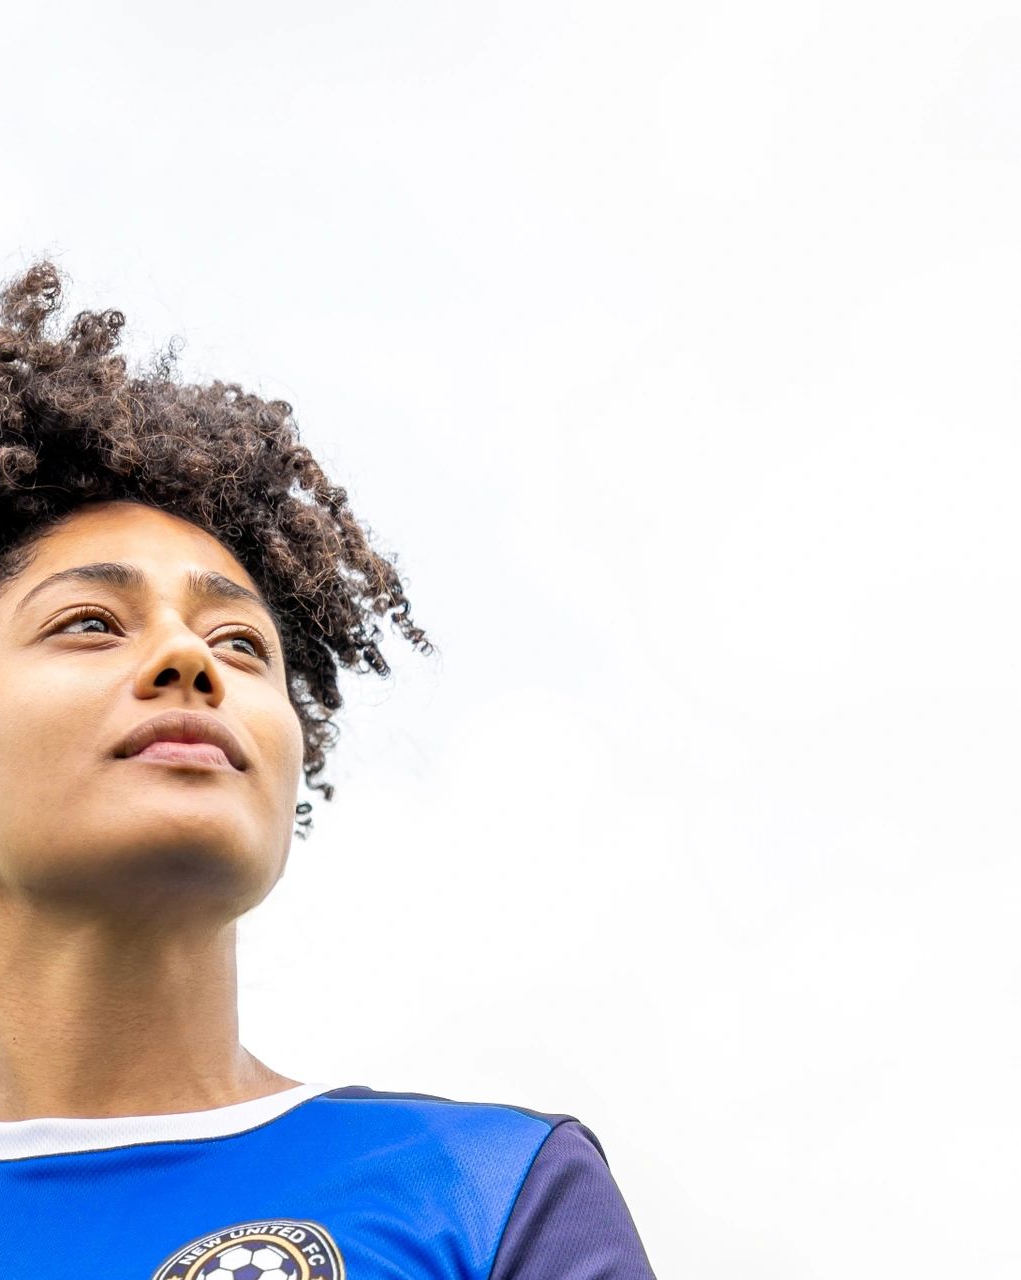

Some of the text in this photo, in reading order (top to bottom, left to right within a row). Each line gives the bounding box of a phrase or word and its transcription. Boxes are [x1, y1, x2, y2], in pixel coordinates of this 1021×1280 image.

[178, 1225, 326, 1267] NEW UNITED FC
